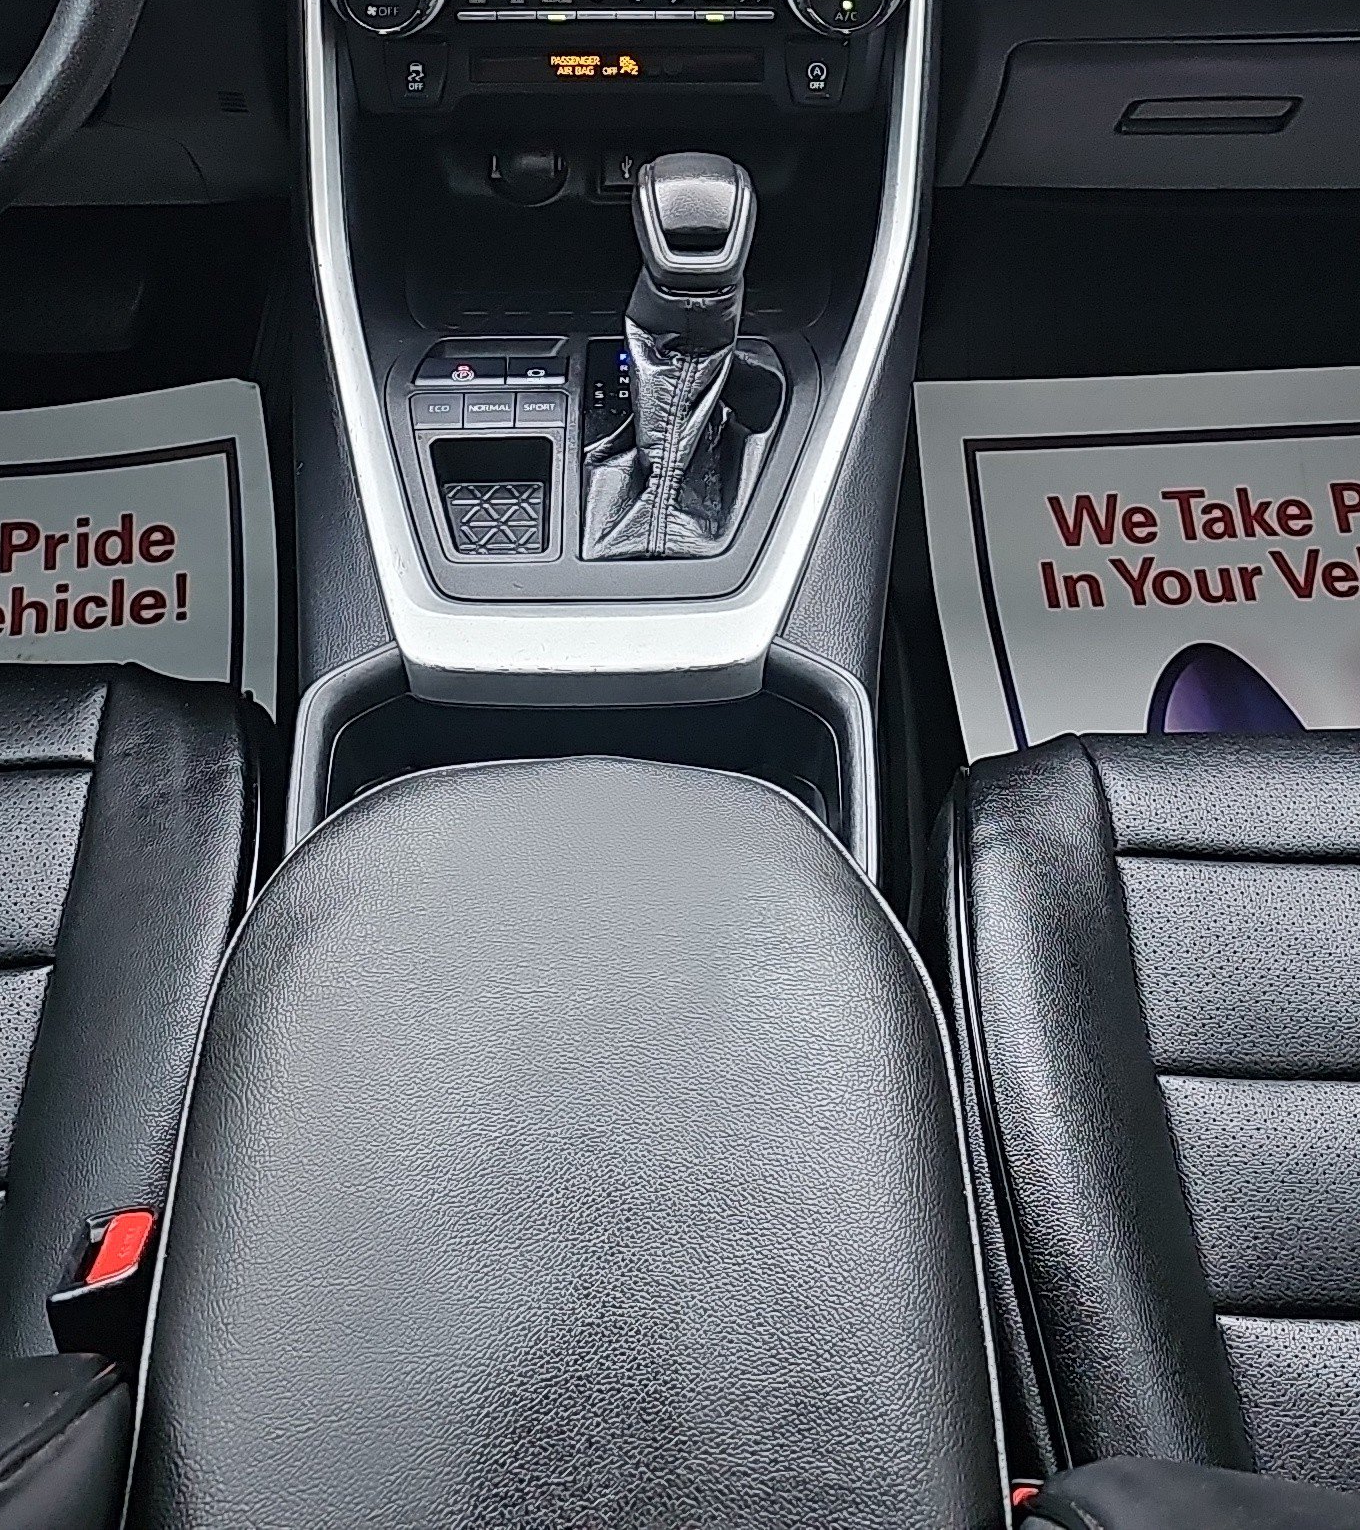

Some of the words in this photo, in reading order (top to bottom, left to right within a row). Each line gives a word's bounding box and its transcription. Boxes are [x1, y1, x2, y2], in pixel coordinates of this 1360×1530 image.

[379, 6, 399, 16] OFF
[834, 11, 857, 22] A/C
[551, 56, 600, 65] PASSENGER
[557, 66, 573, 75] AIR
[575, 66, 594, 75] BAG
[602, 67, 618, 75] OFF
[408, 83, 424, 91] OFF
[809, 81, 825, 90] OFF
[619, 376, 630, 384] N
[619, 390, 629, 398] D
[469, 404, 511, 412] NORMAL
[524, 403, 556, 412] SPORT
[1046, 492, 1159, 548] We
[1161, 485, 1314, 543] Take
[1039, 559, 1106, 610] In
[1108, 555, 1264, 608] Your
